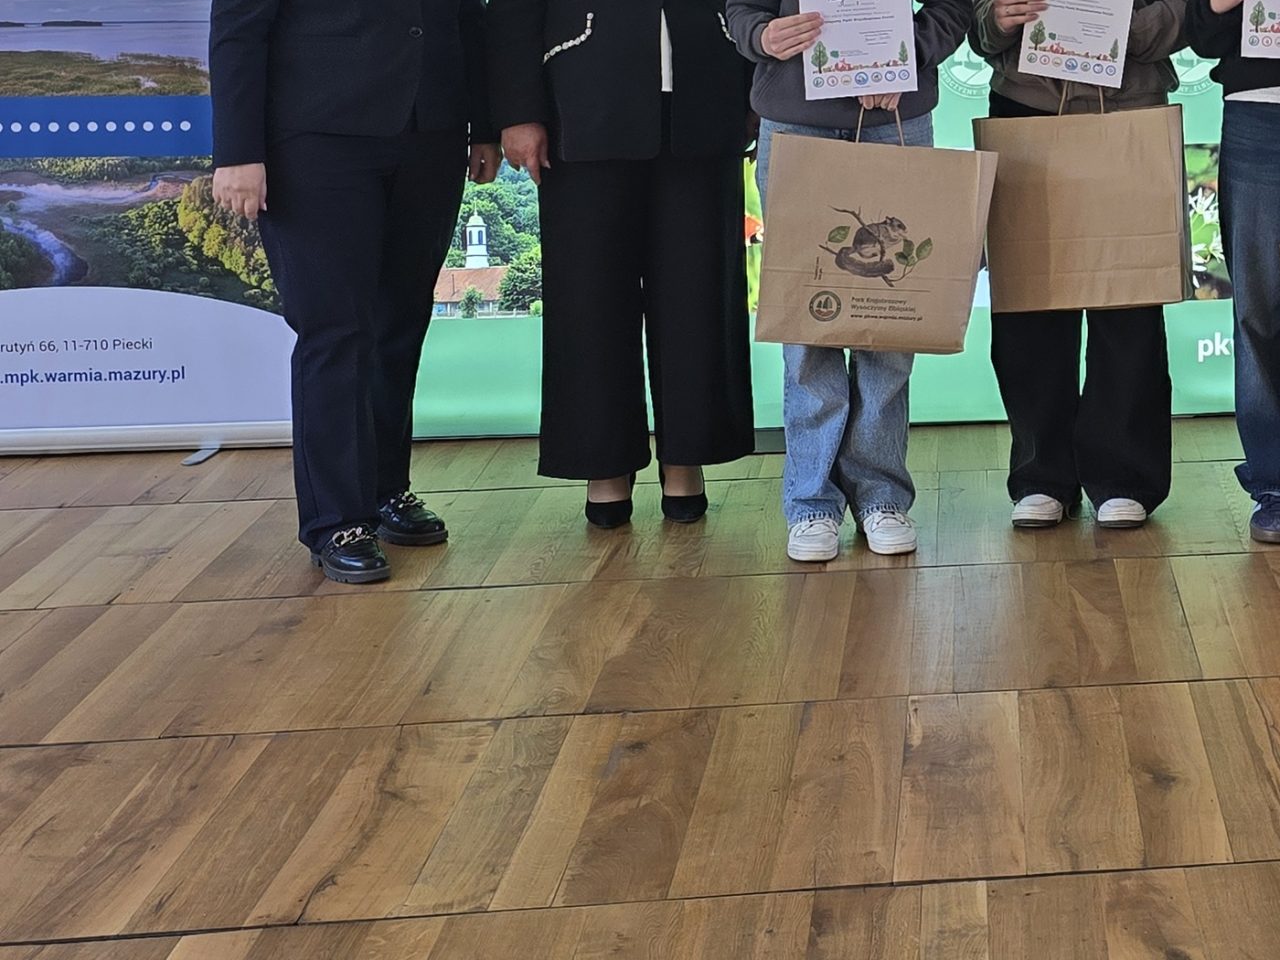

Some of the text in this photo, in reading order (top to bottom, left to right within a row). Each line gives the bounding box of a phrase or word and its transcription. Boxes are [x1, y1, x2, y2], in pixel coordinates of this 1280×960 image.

[0, 337, 153, 355] rutyń 66, 11-710 Piecki
[0, 366, 186, 386] .mpk.warmia.mazury.pl
